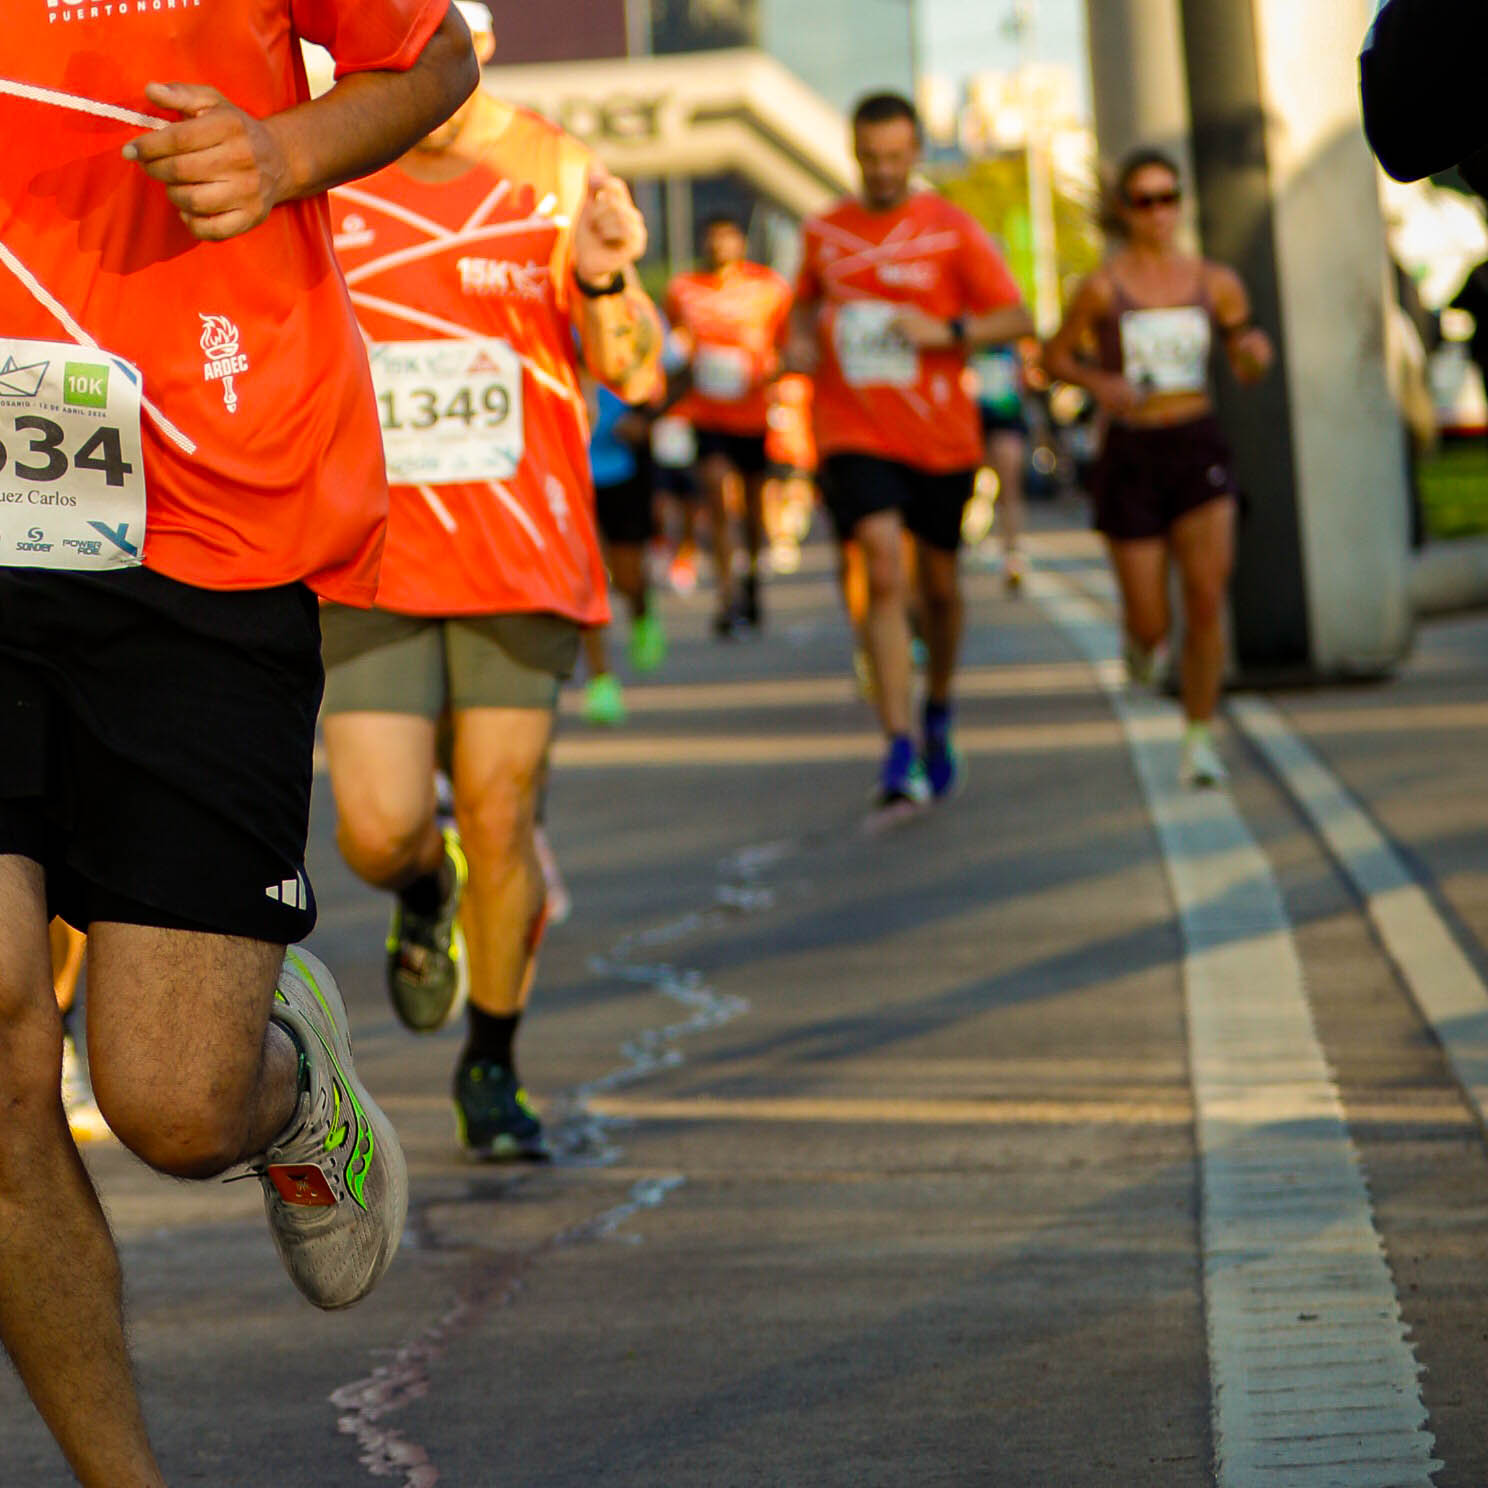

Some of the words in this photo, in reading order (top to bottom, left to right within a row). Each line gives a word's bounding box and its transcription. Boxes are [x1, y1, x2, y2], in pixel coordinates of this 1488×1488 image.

[48, 4, 127, 23] PUERTO
[204, 354, 249, 381] ARDEC
[68, 376, 103, 395] 10K
[378, 383, 510, 430] 1349
[28, 489, 77, 507] Carlos
